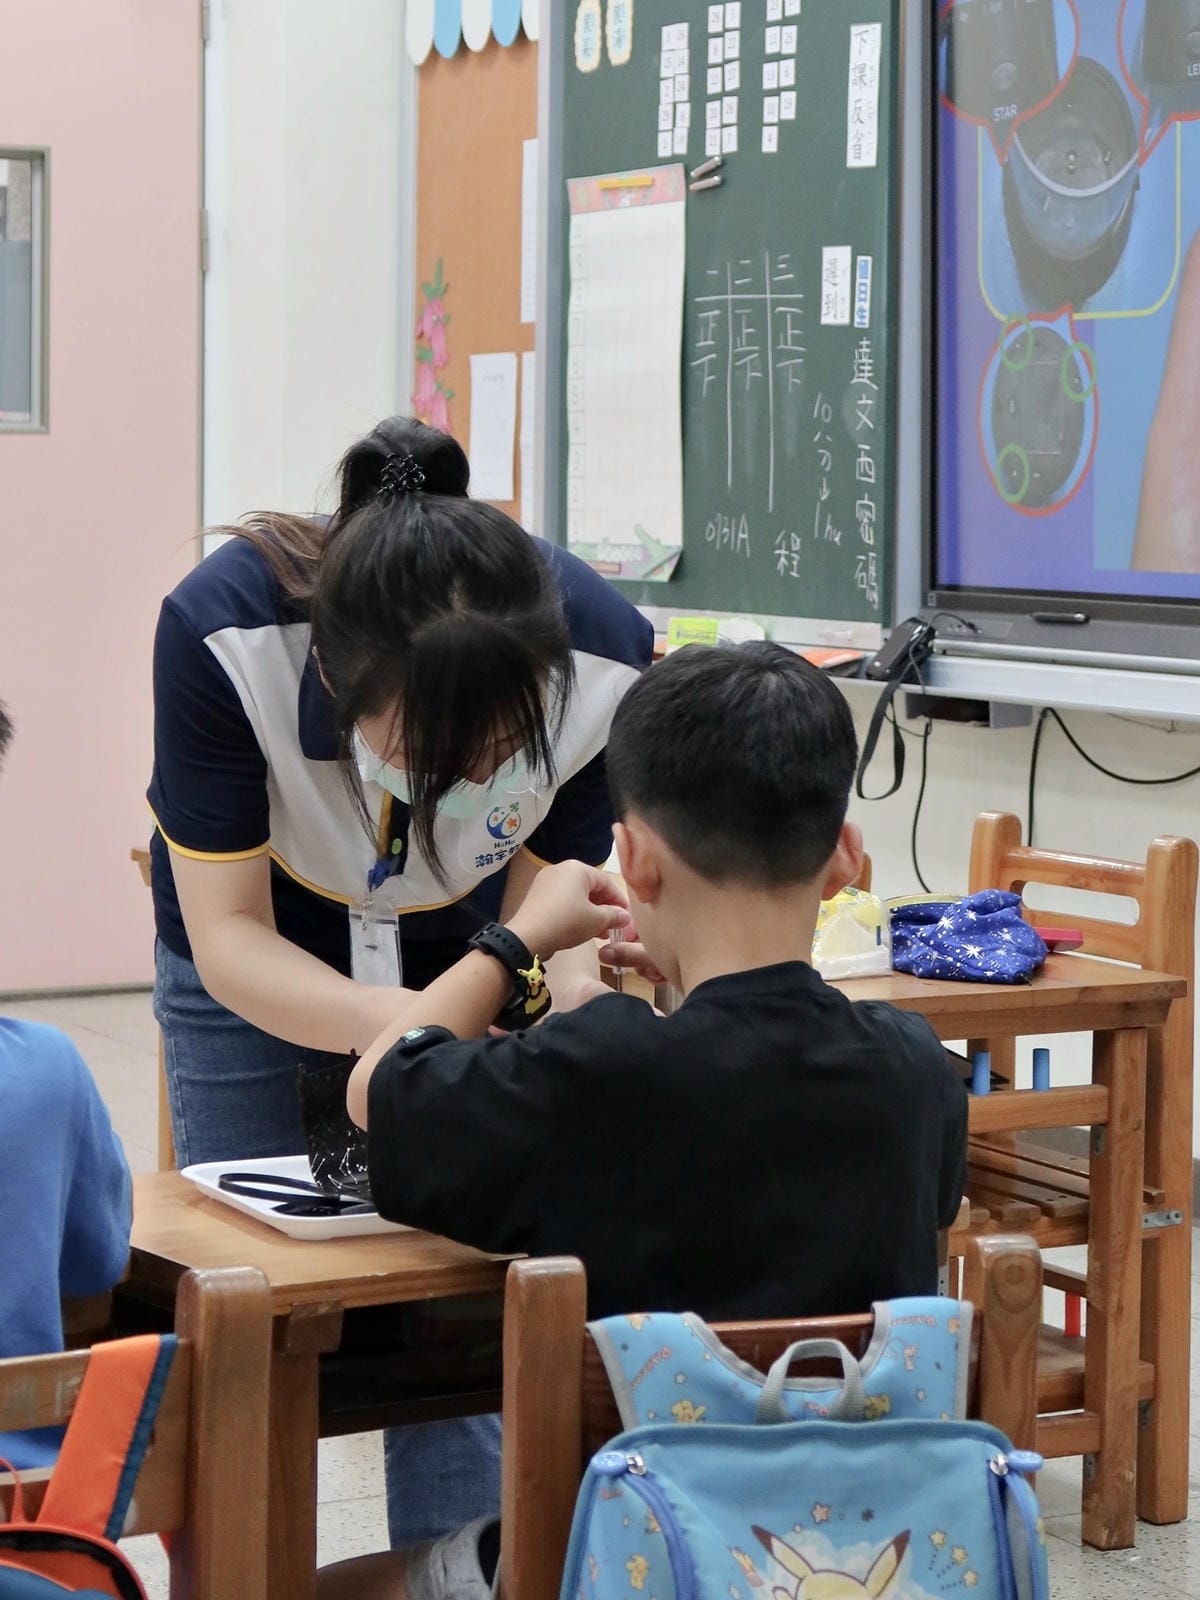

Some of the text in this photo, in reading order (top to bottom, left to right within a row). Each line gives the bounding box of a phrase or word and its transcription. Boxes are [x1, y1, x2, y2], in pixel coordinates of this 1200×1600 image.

[1187, 64, 1200, 77] LE
[851, 30, 869, 160] 下課反省
[993, 104, 1017, 122] STAR
